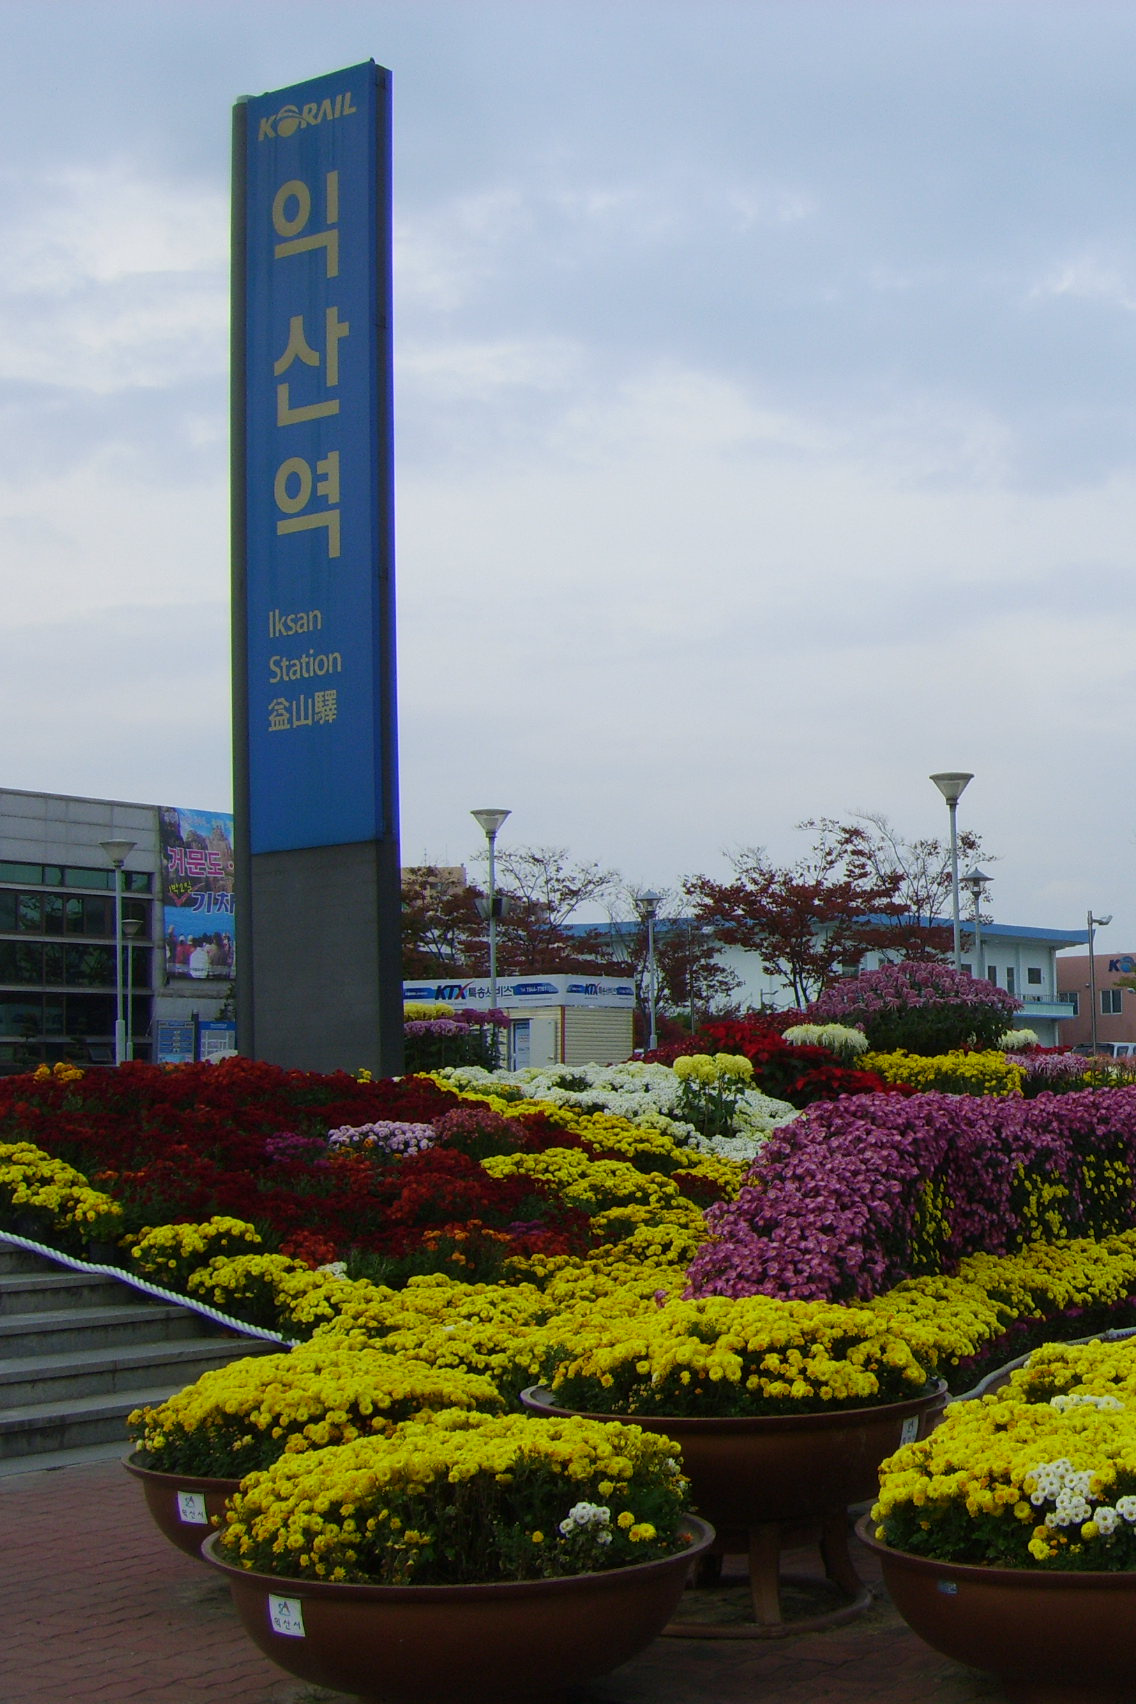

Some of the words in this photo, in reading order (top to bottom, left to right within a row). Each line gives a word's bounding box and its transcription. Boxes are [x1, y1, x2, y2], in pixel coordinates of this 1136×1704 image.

[258, 92, 357, 141] KORAIL
[272, 171, 350, 558] 익산역
[269, 608, 322, 638] Iksan
[269, 648, 342, 683] Station
[434, 981, 475, 1000] KTX
